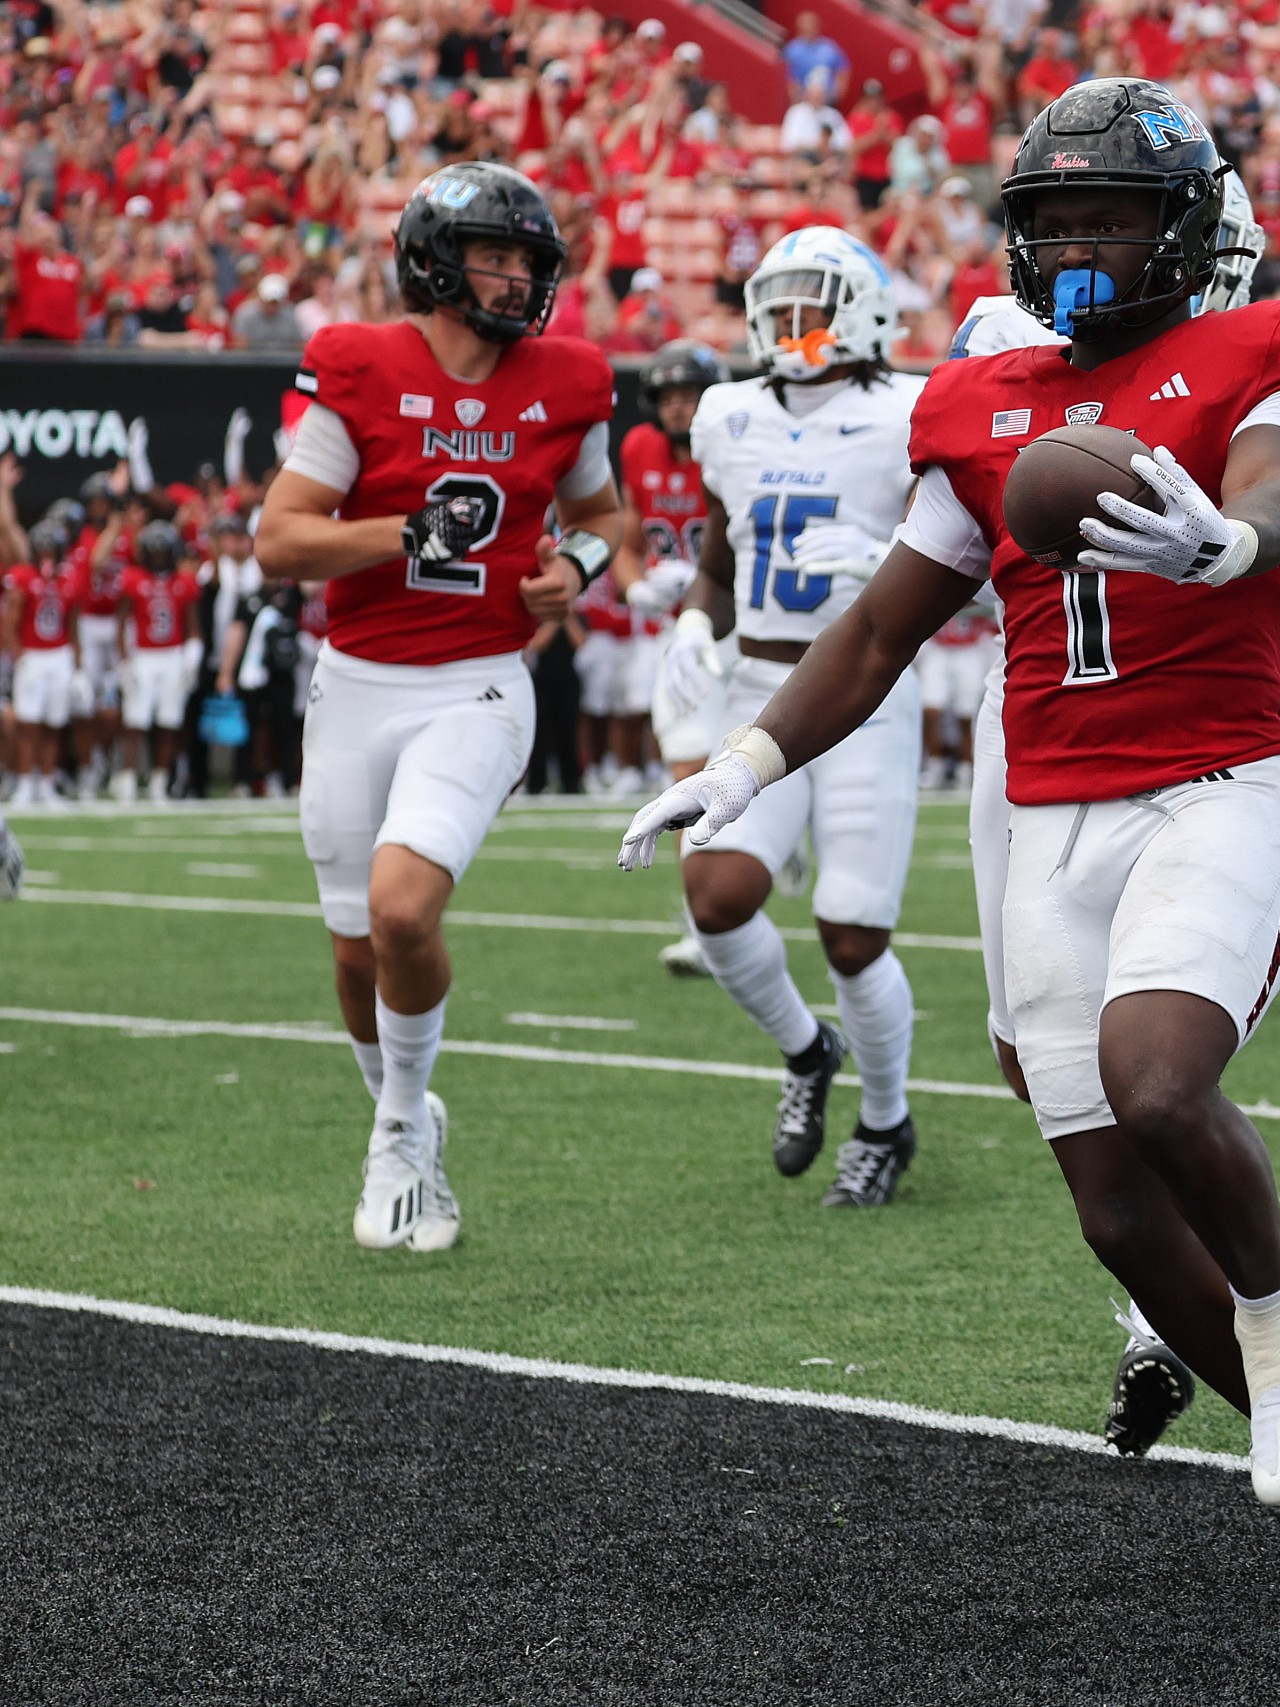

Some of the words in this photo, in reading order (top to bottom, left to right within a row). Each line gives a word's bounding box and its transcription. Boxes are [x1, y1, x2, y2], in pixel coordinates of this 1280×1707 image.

[1051, 152, 1090, 169] Huskies
[0, 409, 128, 458] YOTA
[422, 426, 515, 463] NIU
[759, 469, 826, 485] BUFFALO
[1156, 467, 1186, 496] ADIZERO
[406, 471, 506, 596] 2
[749, 494, 839, 612] 15
[1062, 570, 1119, 686] 1
